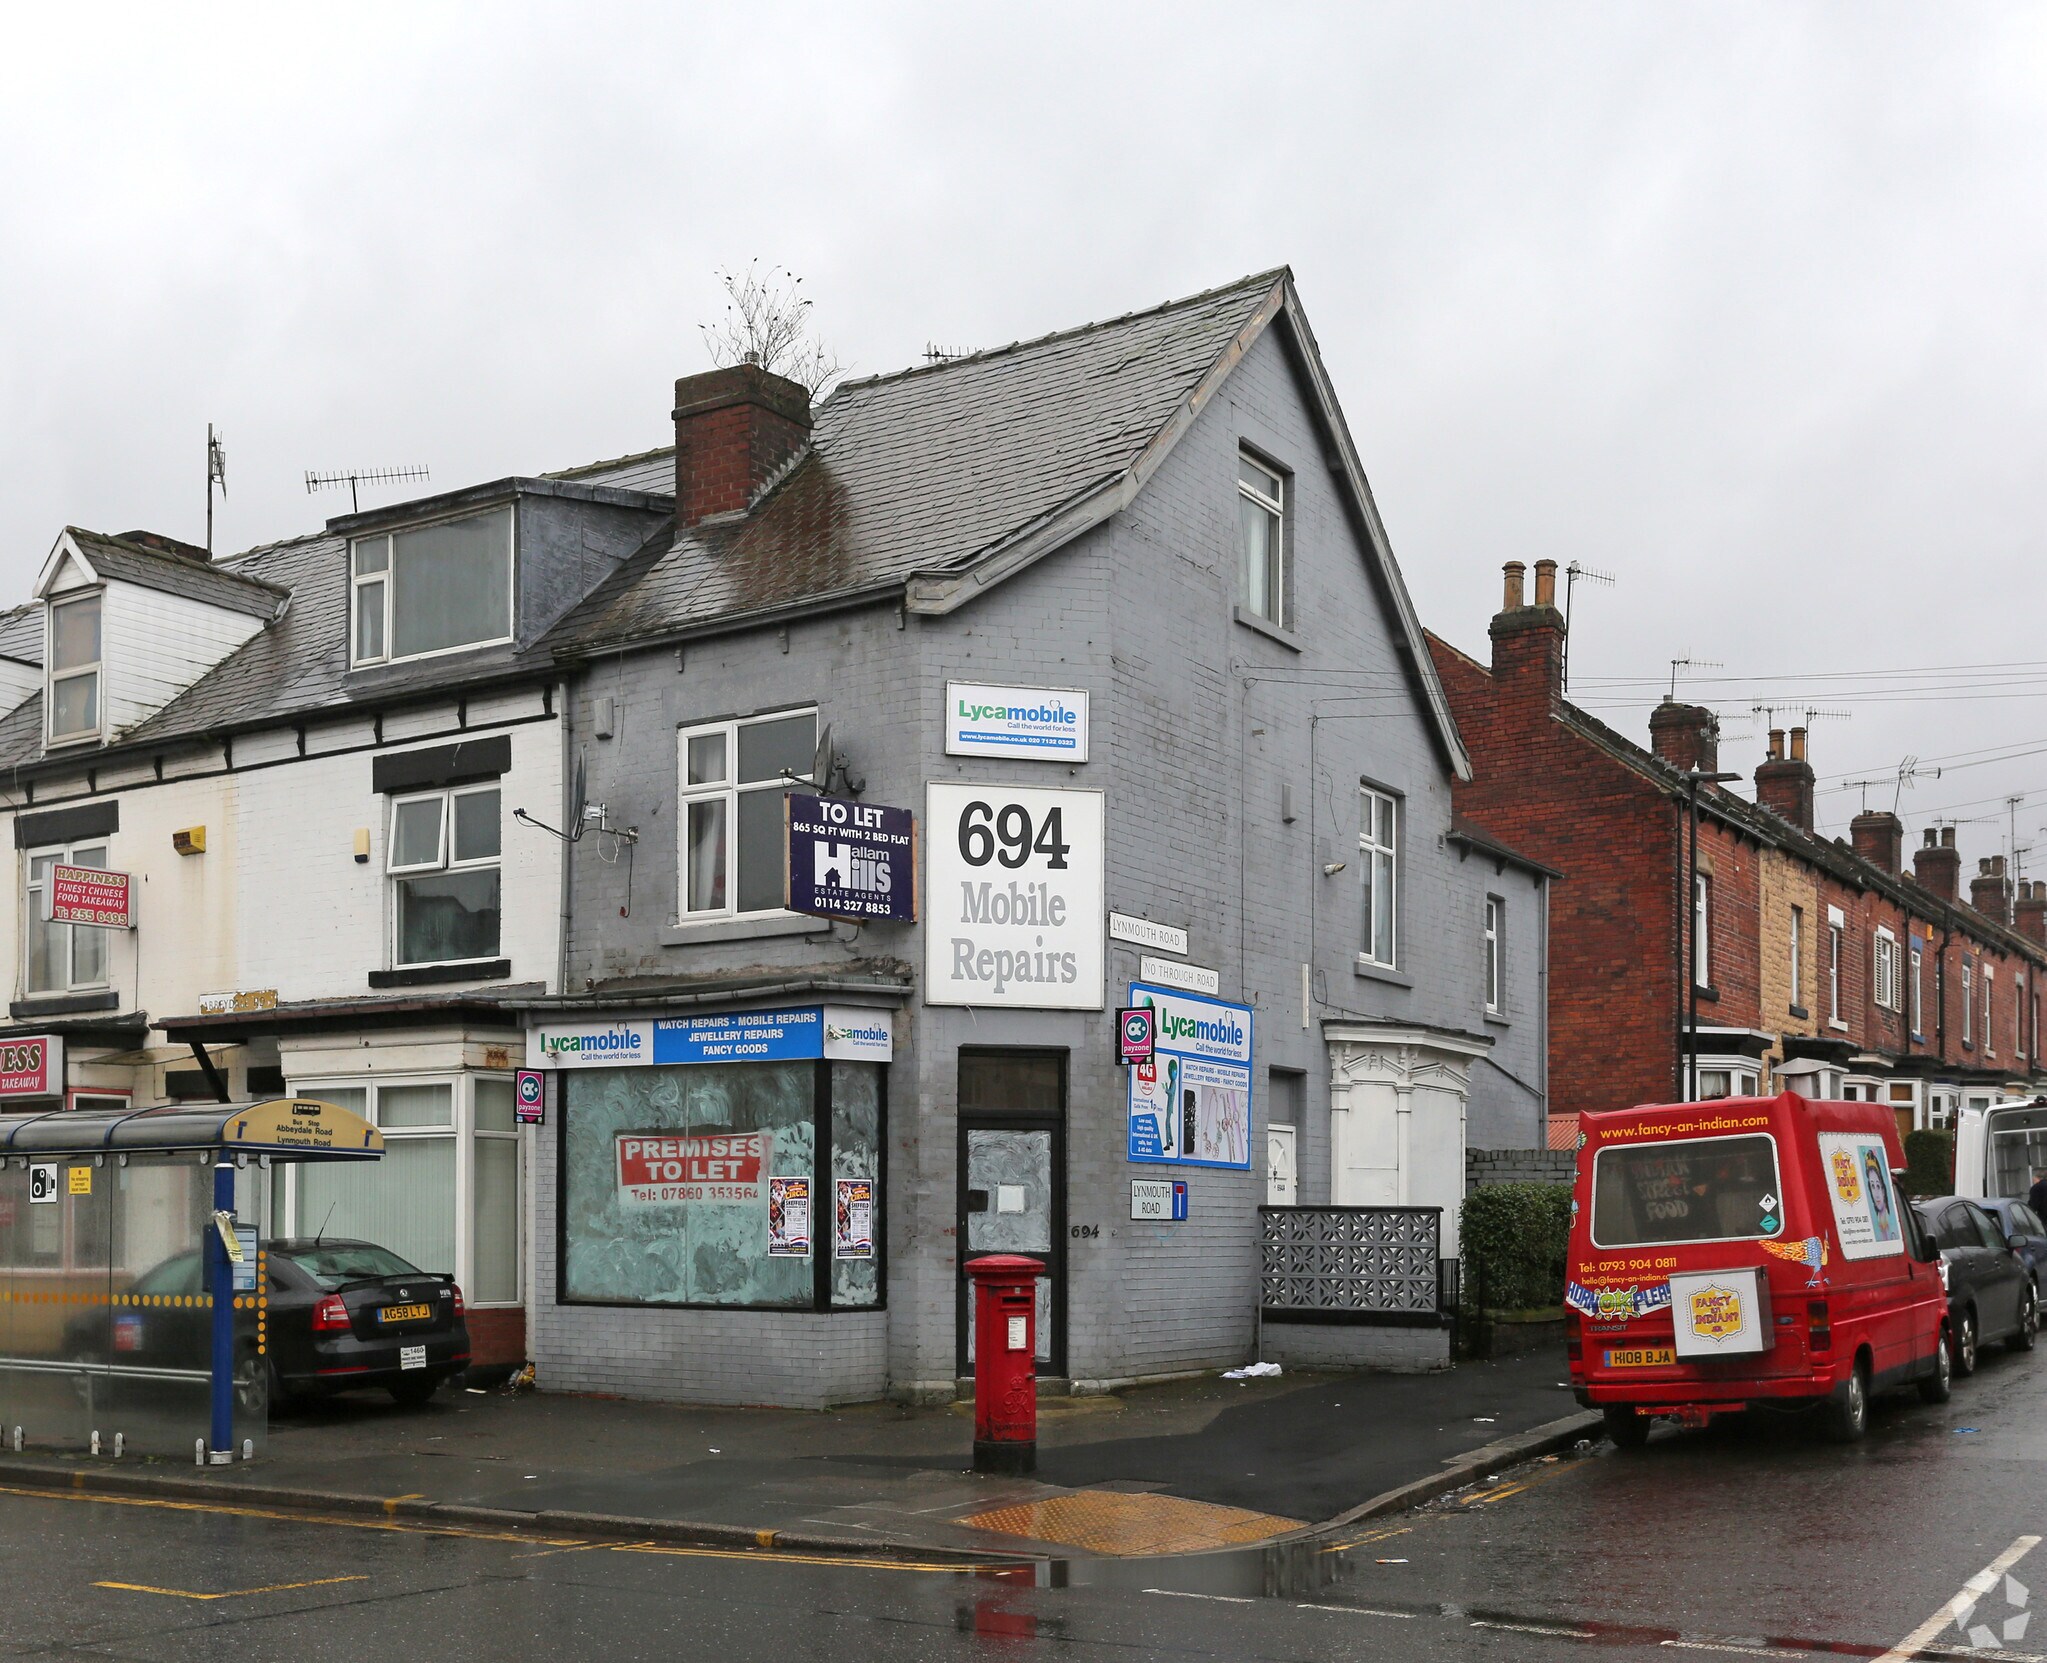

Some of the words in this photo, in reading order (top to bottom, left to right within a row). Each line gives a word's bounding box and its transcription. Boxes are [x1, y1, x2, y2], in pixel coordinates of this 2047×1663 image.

[959, 699, 1076, 724] Lycamobile
[961, 733, 1027, 743] www.lycamobile.co.uk
[819, 801, 847, 823] TO
[854, 807, 883, 828] LET
[793, 822, 810, 832] 865
[812, 825, 826, 834] SQ
[828, 826, 837, 836] FT
[839, 828, 862, 839] WITH
[864, 831, 871, 840] 2
[873, 832, 888, 842] BED
[891, 835, 909, 845] FLAT
[958, 800, 1070, 870] 694
[56, 868, 126, 888] HAPPINESS
[58, 883, 86, 893] FINEST
[88, 886, 124, 898] CHINESE
[815, 887, 849, 897] ESTATE
[855, 892, 891, 902] AGENTS
[57, 893, 79, 903] FOOD
[81, 896, 125, 909] TAKEAWAY
[814, 897, 841, 909] 0114
[843, 900, 863, 911] 327
[865, 903, 891, 914] 8853
[960, 880, 1066, 927] Mobile
[56, 906, 69, 918] T:
[71, 908, 95, 921] 255
[97, 912, 127, 925] 6495
[1113, 918, 1157, 941] LYNMOUTH
[1159, 930, 1180, 946] ROAD
[950, 934, 1077, 994] Repairs
[1144, 962, 1156, 975] NO
[1159, 965, 1194, 984] THROUGH
[1197, 974, 1215, 987] ROAD
[658, 1020, 689, 1030] WATCH
[691, 1017, 730, 1028] REPAIRS
[738, 1015, 774, 1026] MOBILE
[776, 1013, 817, 1024] REPAIRS
[1162, 1008, 1243, 1045] Lycamobile
[688, 1031, 742, 1042] JEWELLERY
[744, 1029, 784, 1040] REPAIRS
[603, 1052, 619, 1060] world
[703, 1045, 733, 1056] FANCY
[735, 1044, 768, 1054] GOODS
[1123, 1045, 1150, 1053] payzone
[1195, 1042, 1205, 1051] Call
[1214, 1046, 1228, 1055] world
[1234, 1049, 1242, 1058] less
[1139, 1063, 1154, 1078] 4G
[1199, 1066, 1214, 1074] REPAIRS
[1217, 1068, 1231, 1076] MOBILE
[1231, 1071, 1246, 1079] REPAIRS
[2, 1076, 40, 1090] TAKEAWAY
[1183, 1073, 1204, 1081] JEWELLERY
[1205, 1075, 1220, 1083] REPAIRS
[1223, 1078, 1235, 1086] FANCY
[1235, 1080, 1248, 1088] GOODS
[518, 1104, 541, 1112] payzone
[276, 1124, 312, 1134] Abbeydale
[315, 1127, 333, 1136] Road
[1600, 1116, 1768, 1139] www.fancy-an-indian.com
[277, 1136, 311, 1145] Lynmouth
[313, 1138, 332, 1147] Road
[625, 1138, 761, 1161] PREMISES
[645, 1161, 682, 1181] TO
[691, 1160, 743, 1180] LET
[631, 1189, 657, 1201] Tel:
[661, 1187, 703, 1200] 07860
[785, 1190, 807, 1200] CIRCUS
[850, 1192, 870, 1201] CIRCUS
[1133, 1185, 1171, 1198] LYNMOUTH
[1141, 1201, 1160, 1214] ROAD
[1071, 1223, 1100, 1239] 694
[1579, 1262, 1595, 1273] Tel:
[1599, 1260, 1626, 1272] 0793
[1629, 1259, 1651, 1270] 904
[1655, 1257, 1677, 1268] 0811
[1581, 1274, 1669, 1286] hello@fancy-an-indian.co
[1567, 1281, 1600, 1313] HORN
[1695, 1296, 1731, 1308] FANCY
[384, 1307, 408, 1320] AG58
[410, 1306, 428, 1317] LTJ
[1695, 1311, 1739, 1324] INDIAN?
[1590, 1324, 1627, 1332] TRANSIT
[1614, 1351, 1642, 1364] H108
[1645, 1350, 1671, 1363] BJA
